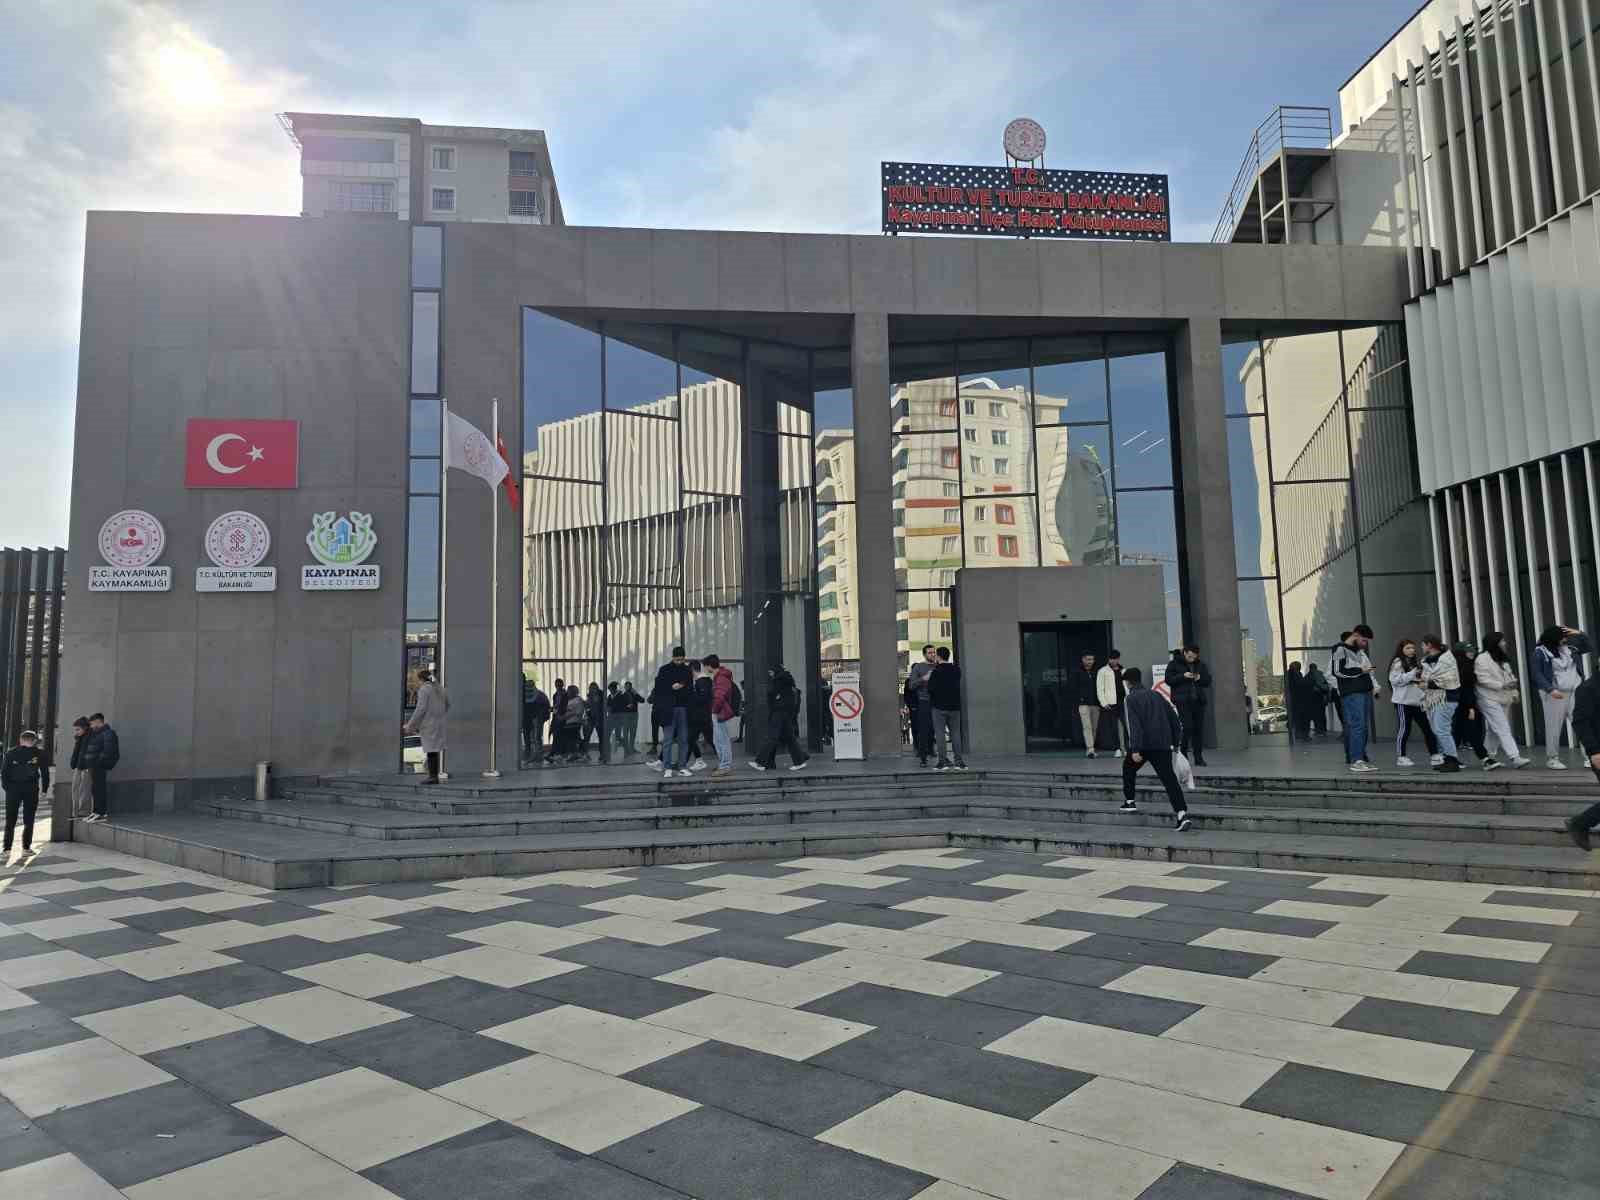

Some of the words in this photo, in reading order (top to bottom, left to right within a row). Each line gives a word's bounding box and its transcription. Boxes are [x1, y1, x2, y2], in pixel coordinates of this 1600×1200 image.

[888, 183, 964, 203] KÜLTÜR
[967, 187, 993, 206] VE
[1018, 210, 1056, 229] Halk
[92, 569, 110, 577] T.C.
[112, 569, 168, 578] KAYAPINAR
[304, 568, 377, 578] KAYAPINAR
[91, 578, 168, 588] KAYMAKAMLIĞI
